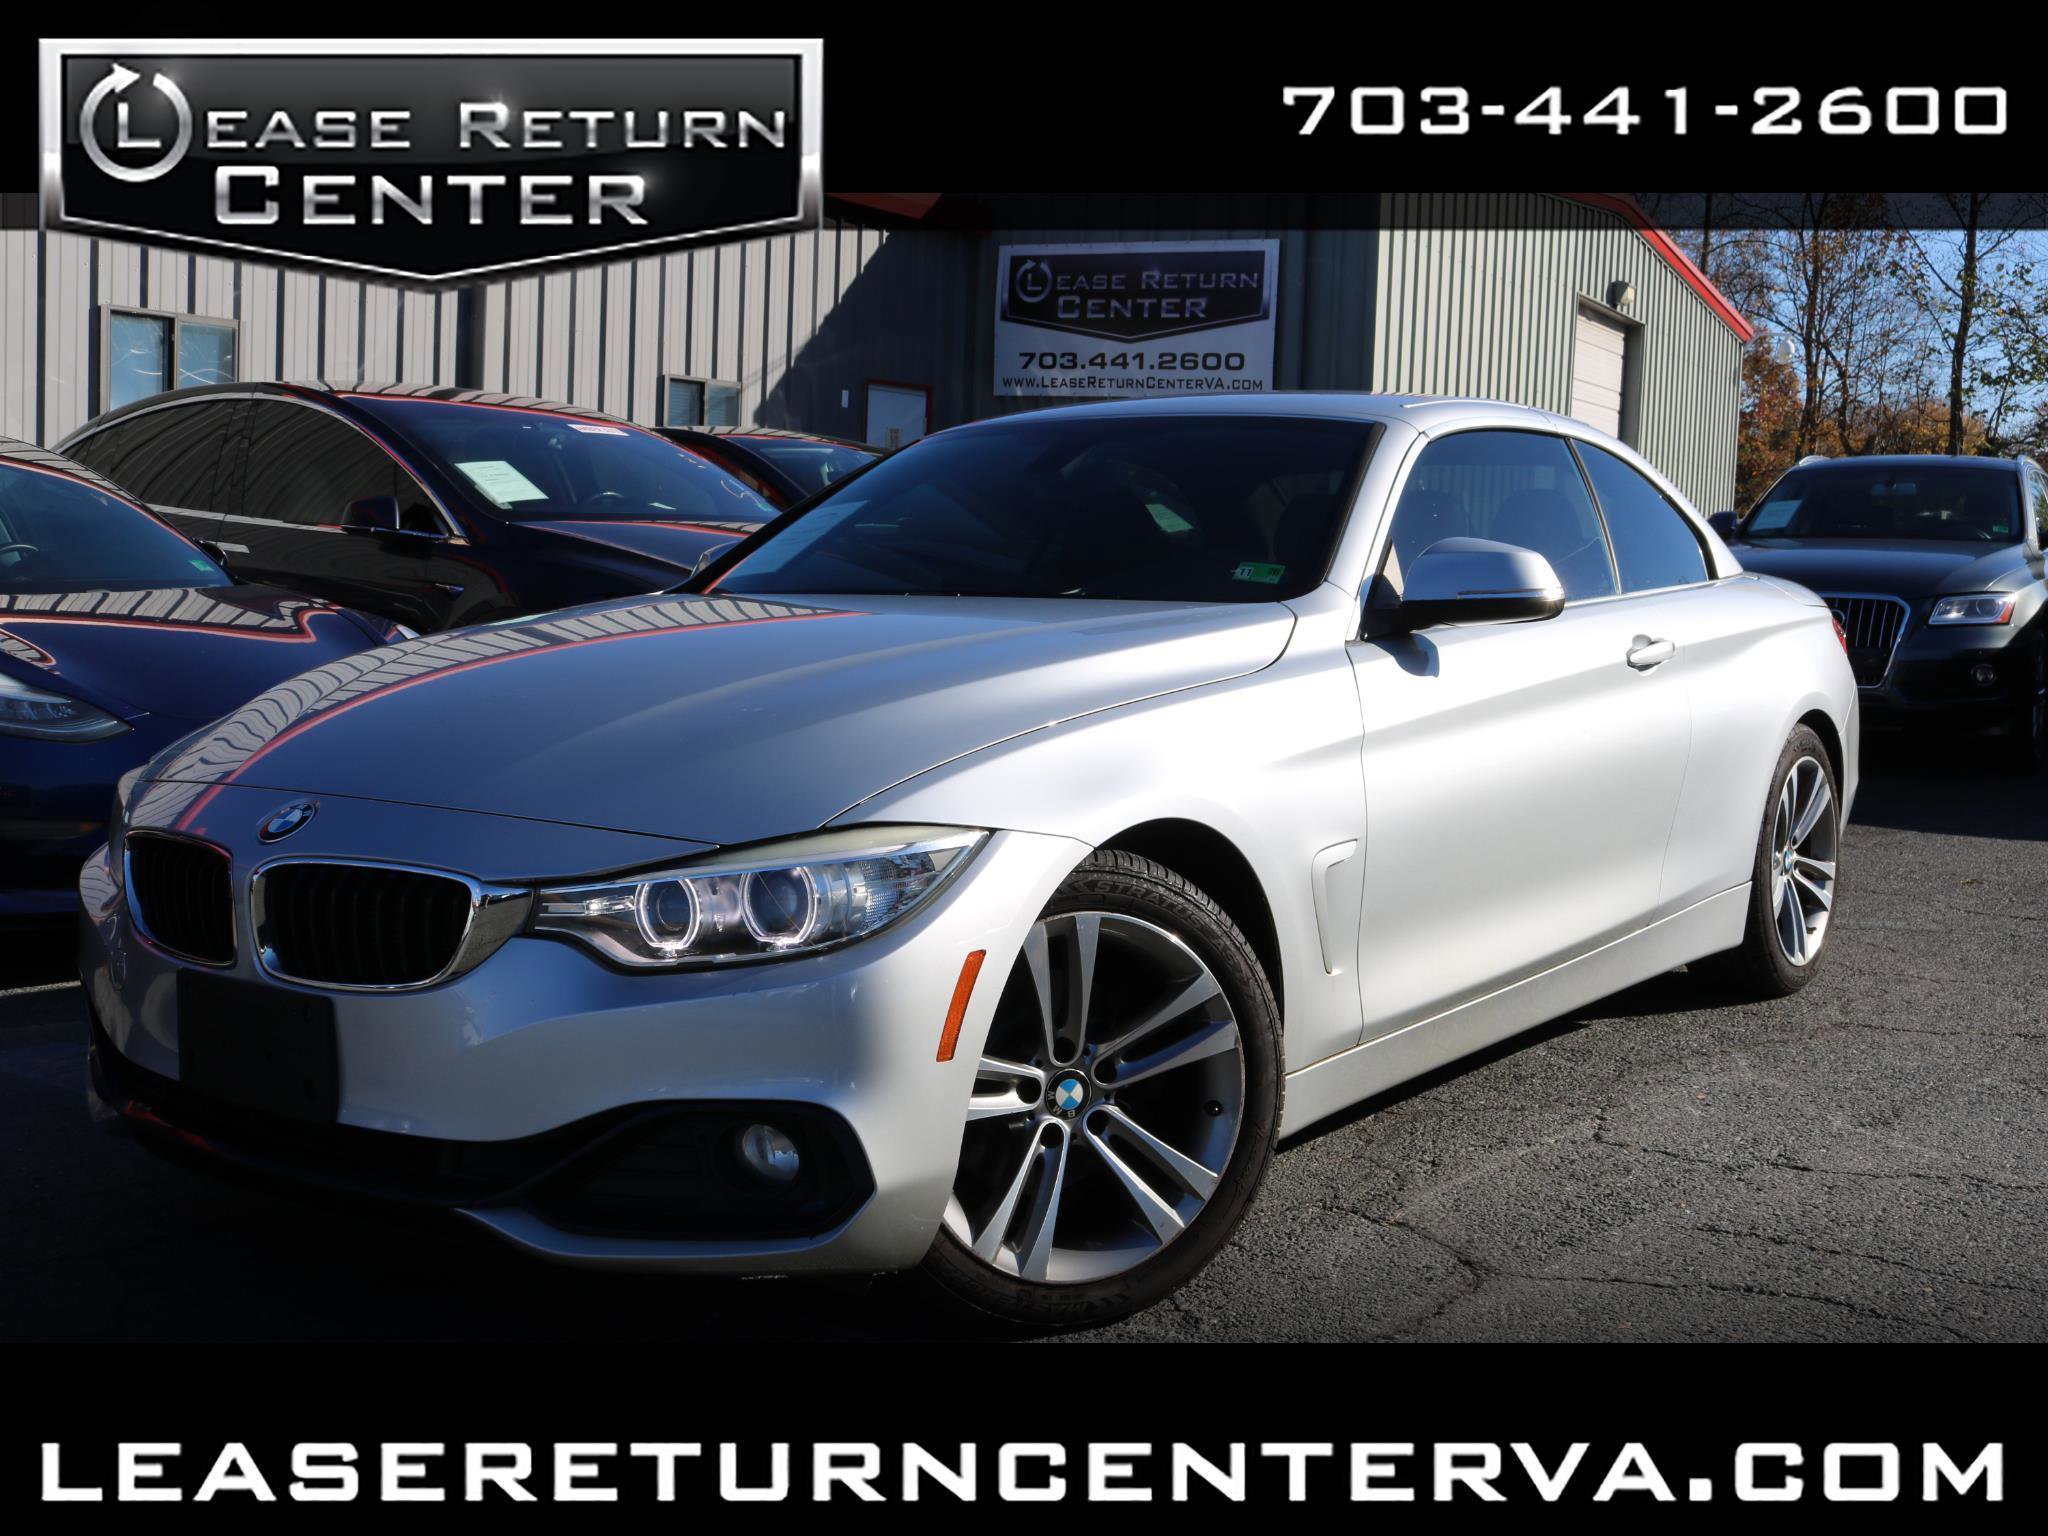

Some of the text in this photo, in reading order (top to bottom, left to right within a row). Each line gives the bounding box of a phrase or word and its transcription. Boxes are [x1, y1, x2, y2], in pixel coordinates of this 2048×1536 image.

[1026, 270, 1259, 292] LEASE RETURN
[1057, 295, 1207, 319] CENTER
[1018, 351, 1246, 371] 703.441.2600
[1094, 879, 1208, 928] STRATUS
